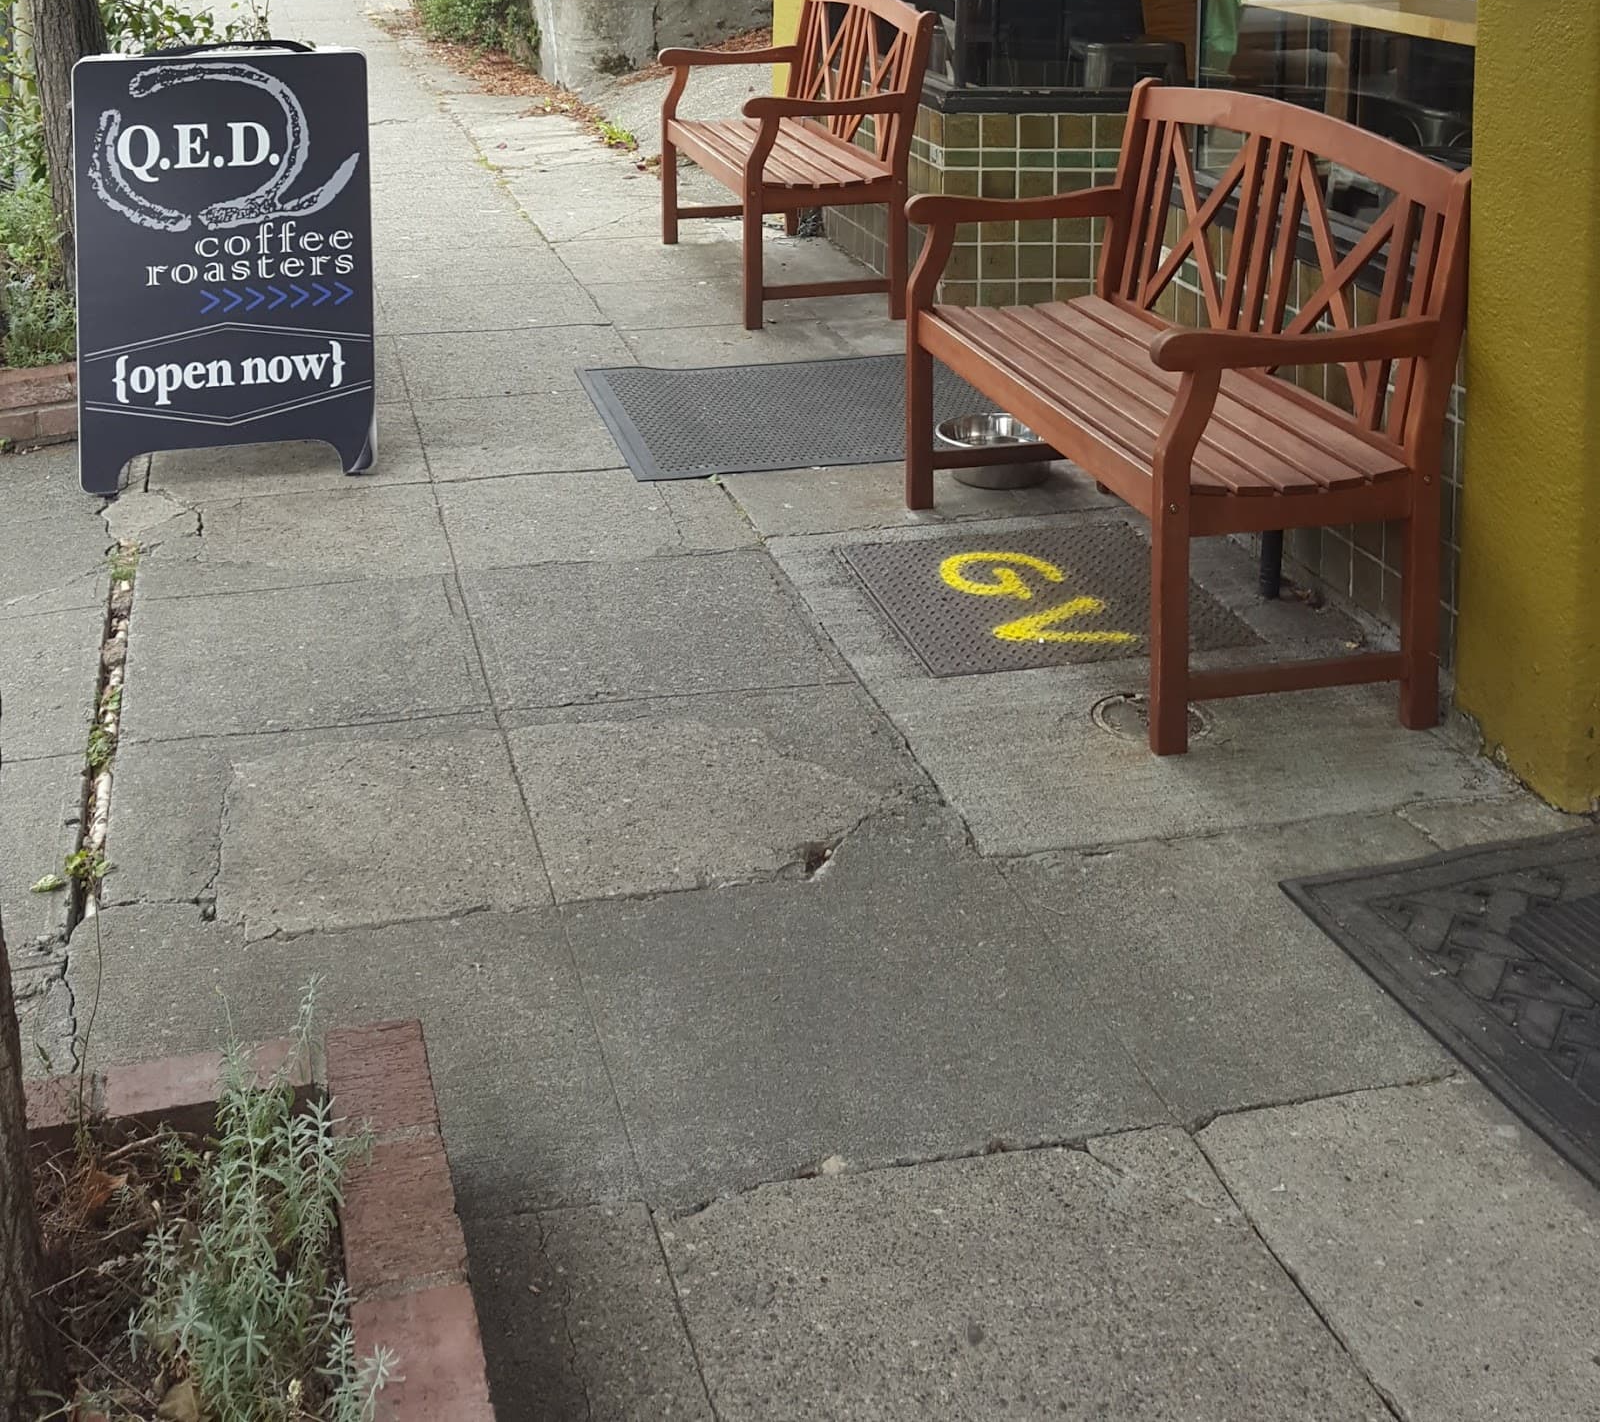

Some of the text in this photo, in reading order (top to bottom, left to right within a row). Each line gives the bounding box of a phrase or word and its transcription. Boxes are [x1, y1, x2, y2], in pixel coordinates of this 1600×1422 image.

[117, 121, 281, 182] Q.E.D.
[194, 220, 355, 259] coffee
[145, 252, 355, 287] roasters
[111, 340, 346, 406] {open now}
